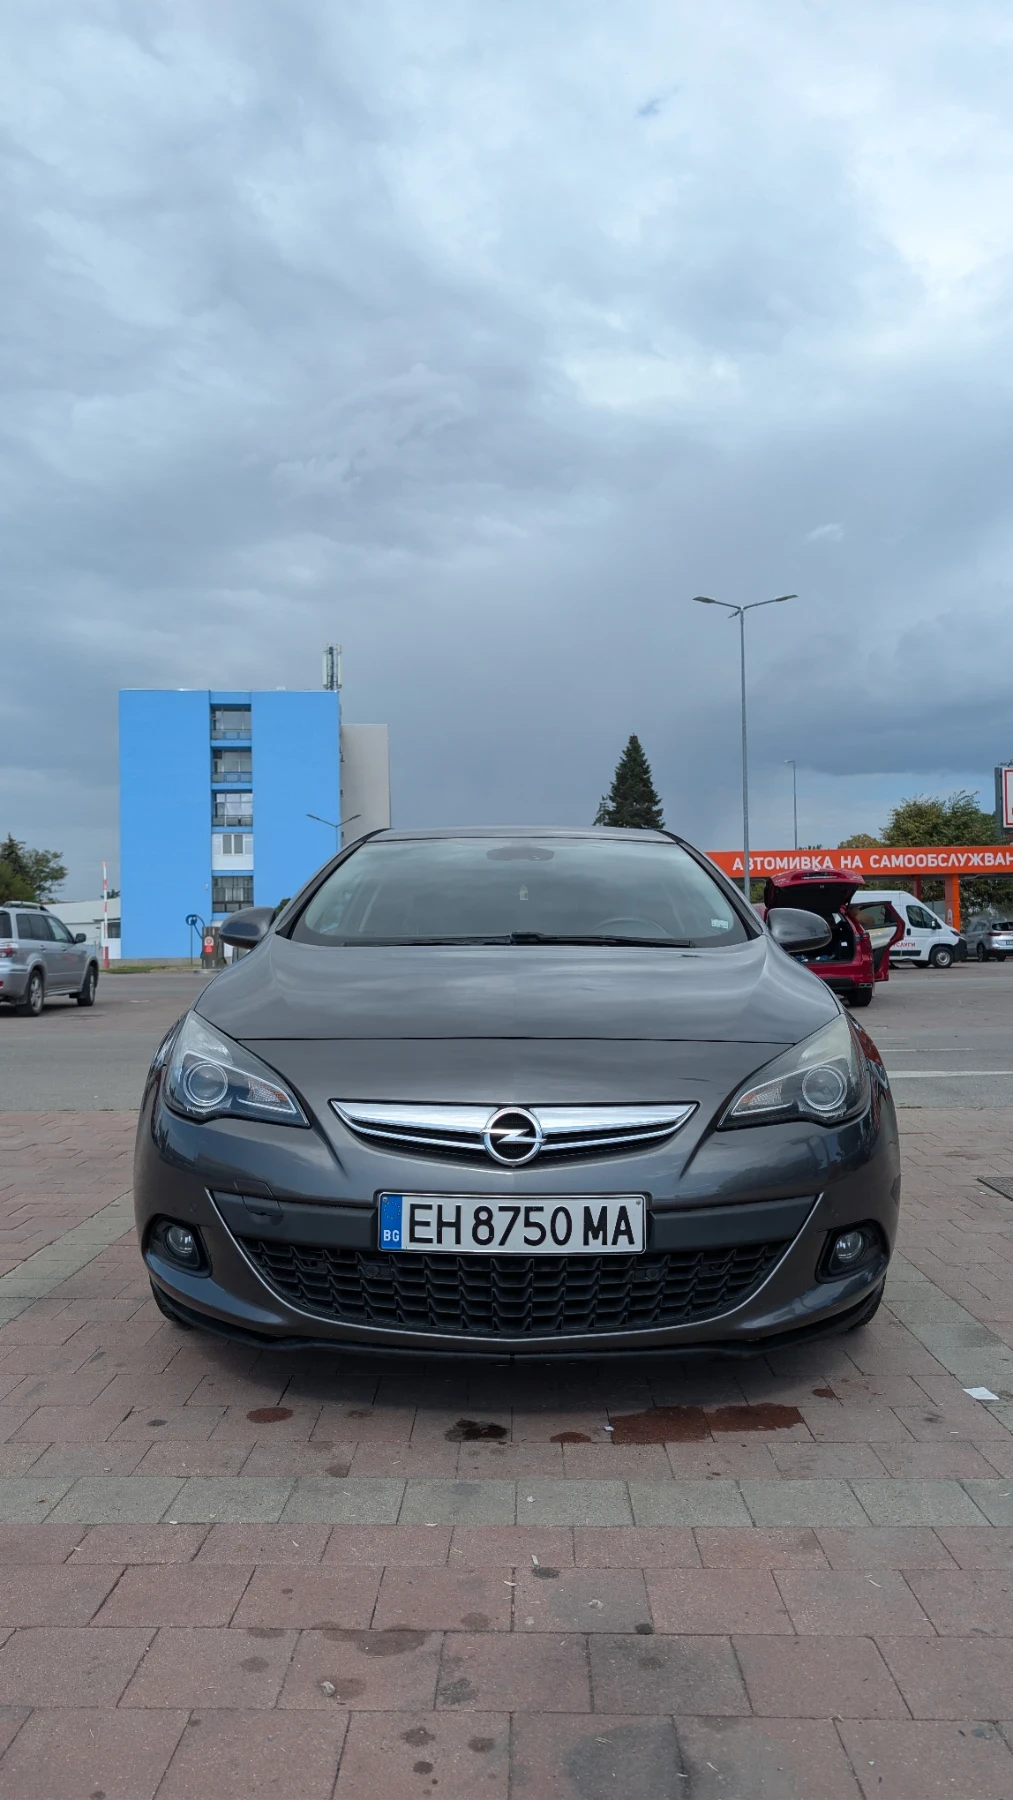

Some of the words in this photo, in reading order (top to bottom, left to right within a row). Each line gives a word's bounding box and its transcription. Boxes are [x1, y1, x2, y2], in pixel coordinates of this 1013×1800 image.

[840, 855, 863, 869] НА
[409, 1203, 462, 1244] EH
[471, 1206, 573, 1246] 8750
[582, 1205, 635, 1246] MA
[383, 1229, 400, 1242] BG
